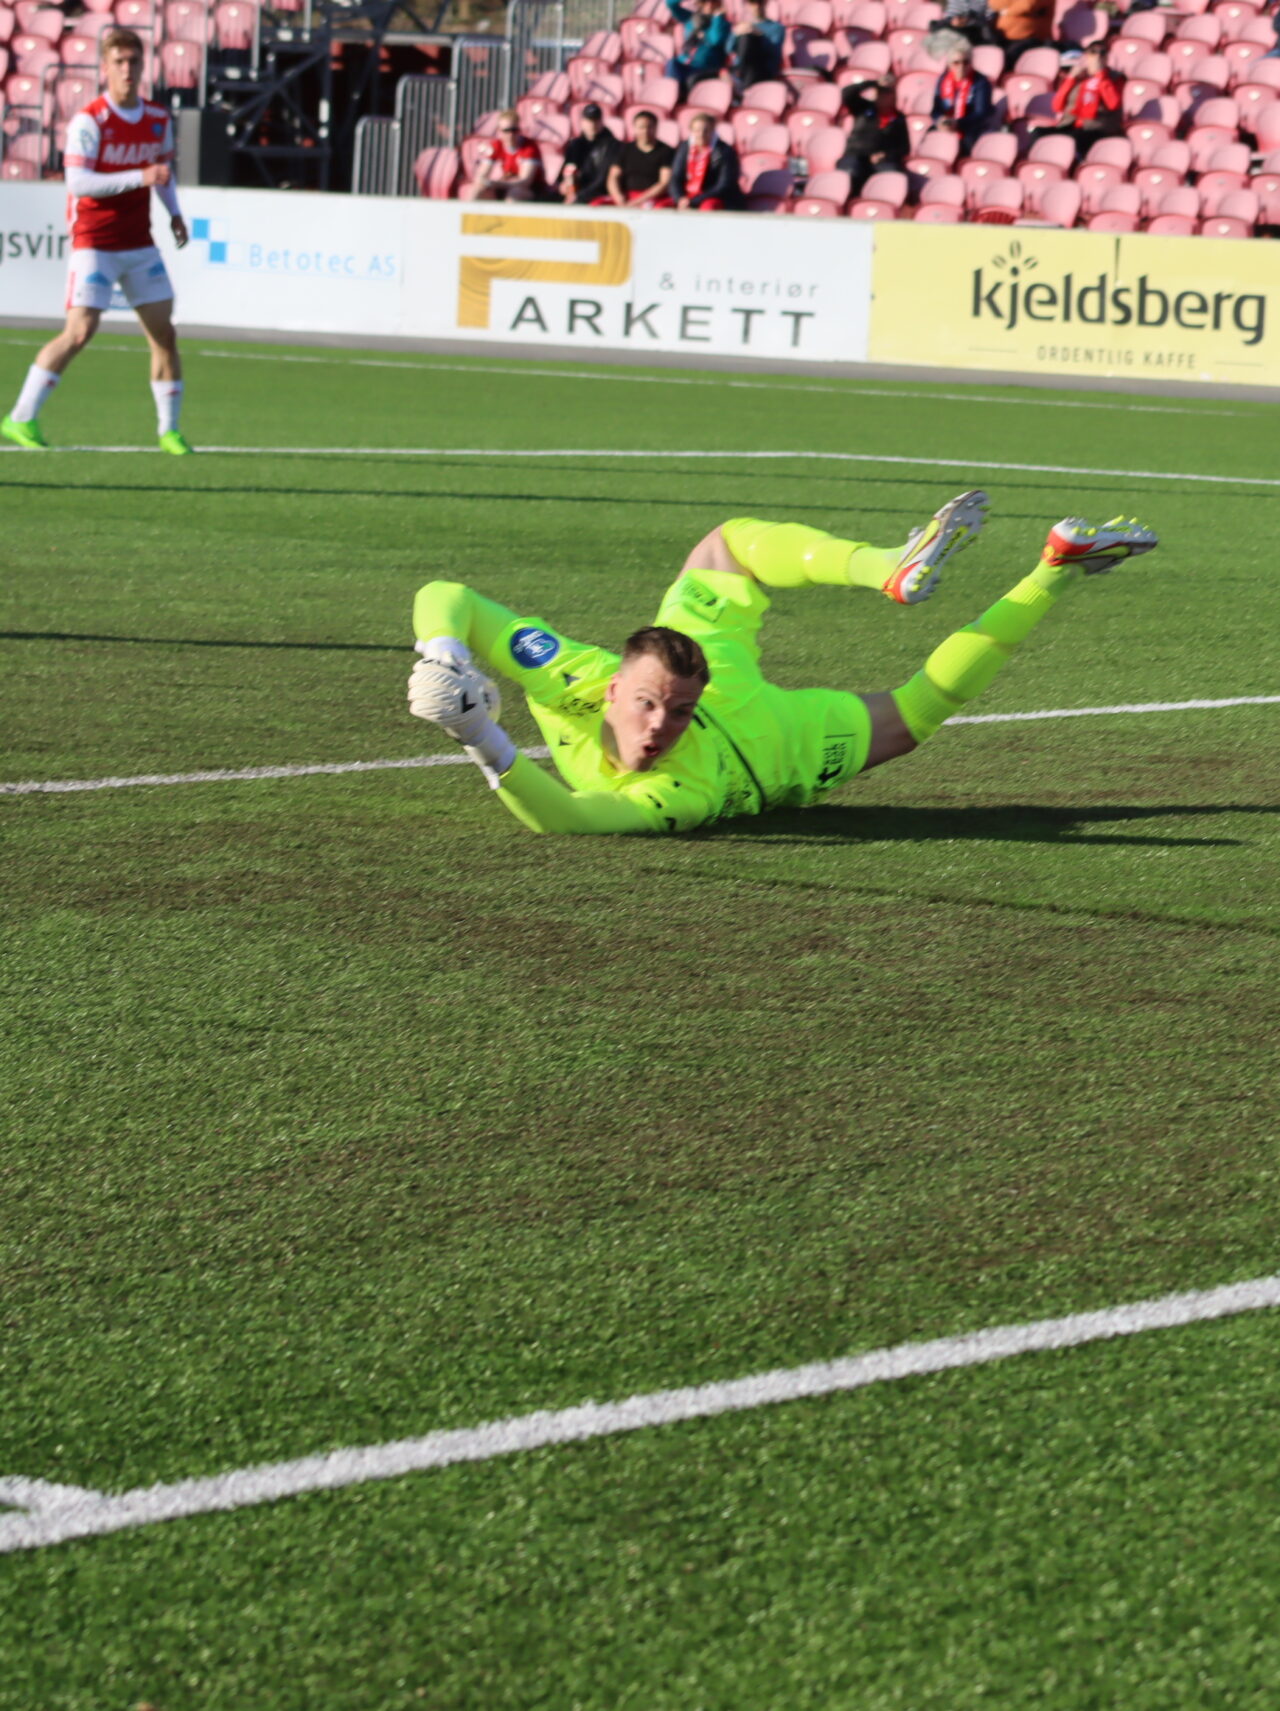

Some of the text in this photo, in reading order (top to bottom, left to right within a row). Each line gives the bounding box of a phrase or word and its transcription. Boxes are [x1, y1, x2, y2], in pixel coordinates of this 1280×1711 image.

[249, 243, 397, 277] Betotec AS
[659, 272, 819, 297] & interiør
[971, 266, 1266, 346] kjeldsberg
[1036, 345, 1197, 370] ORDENTLIG KAFFE
